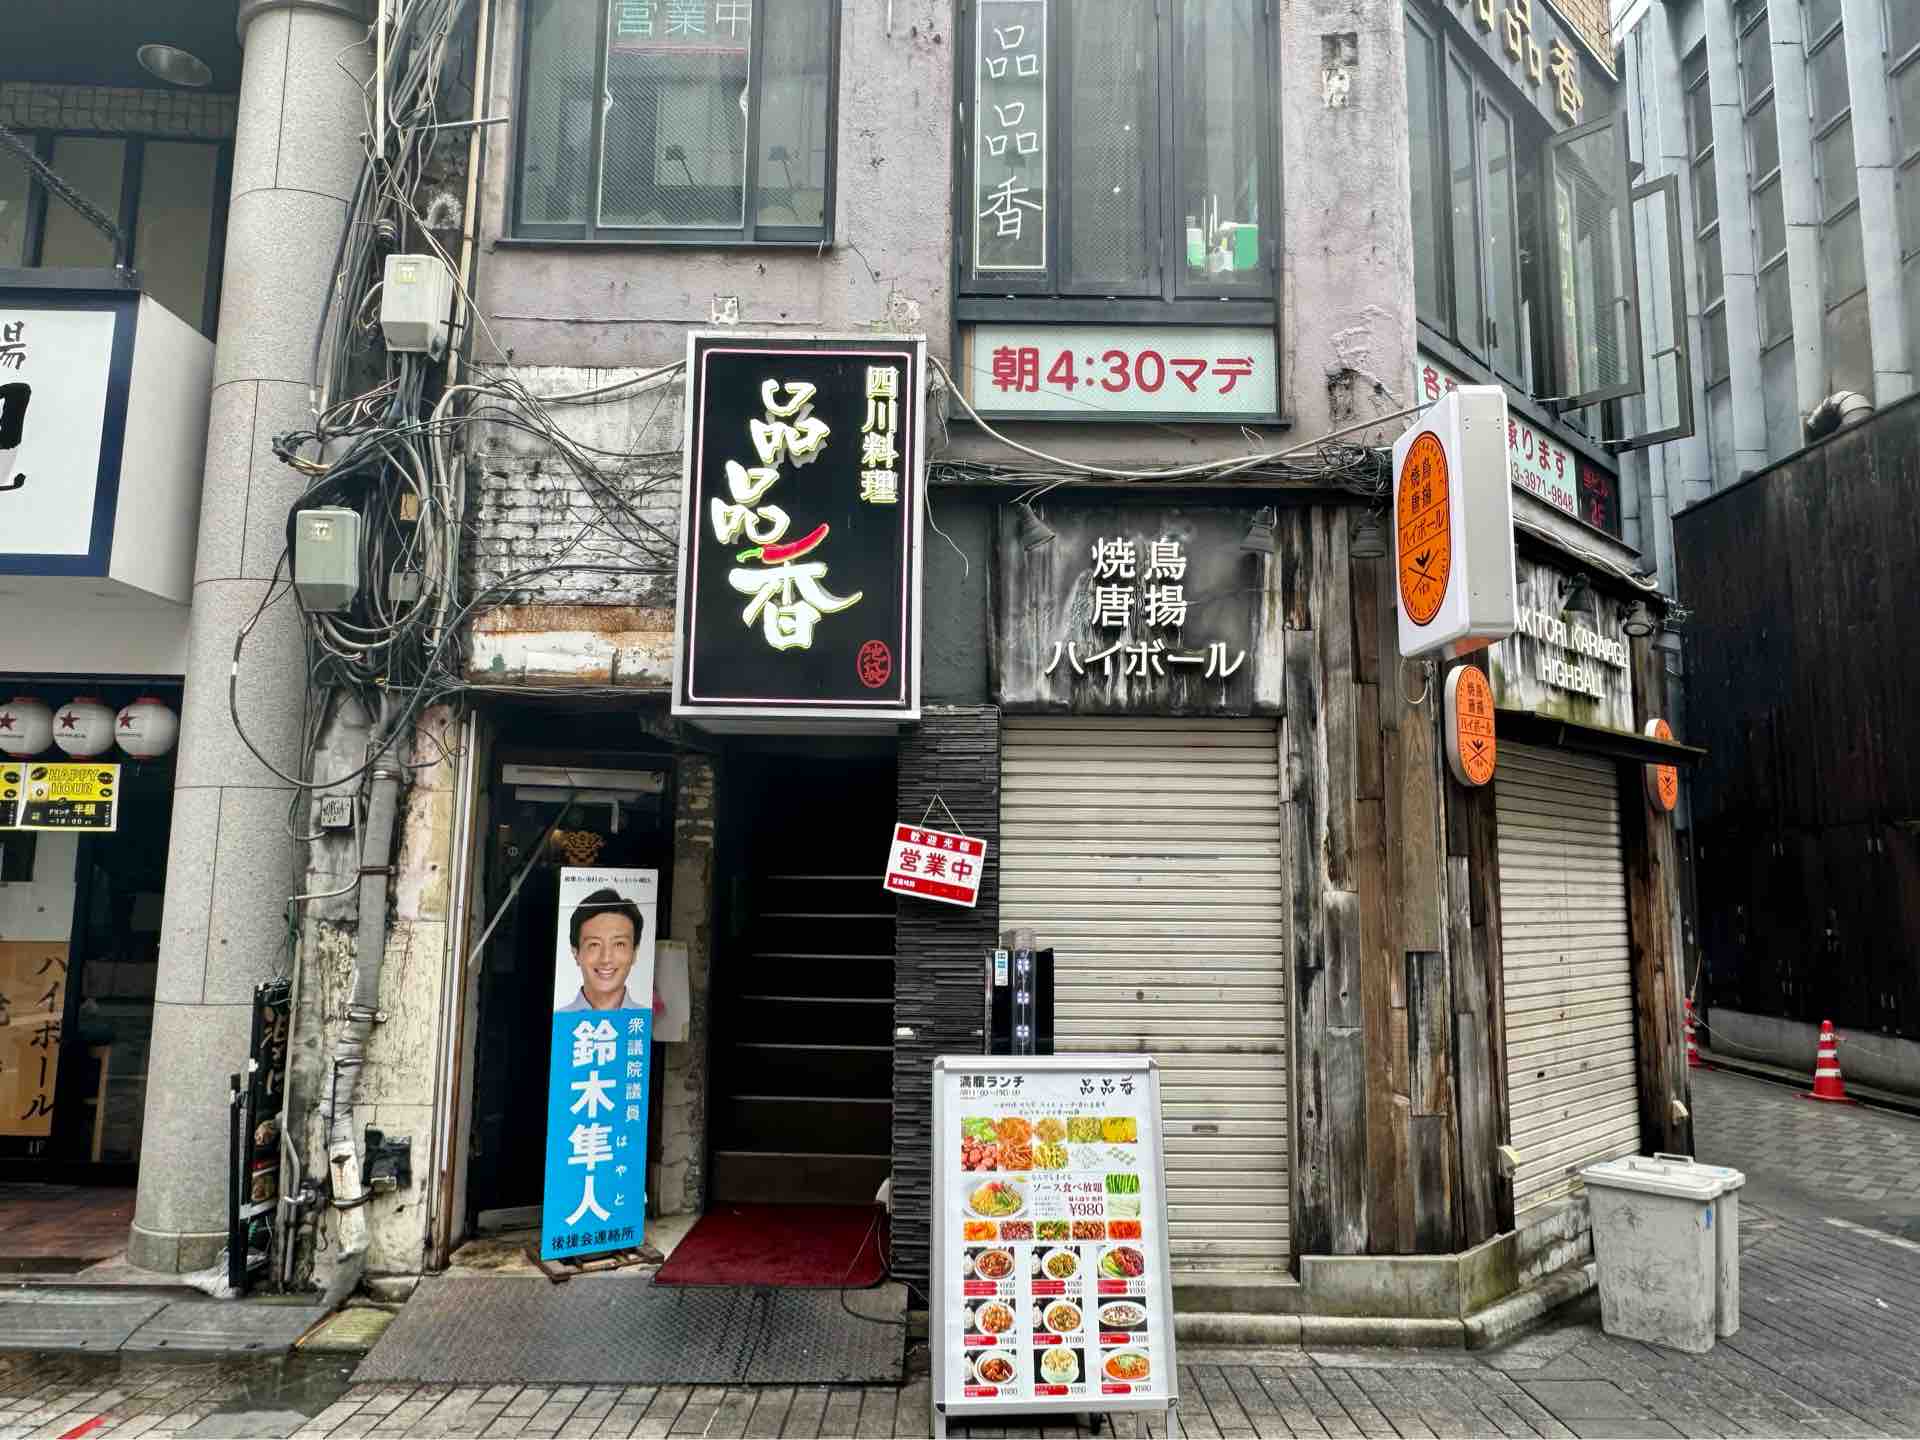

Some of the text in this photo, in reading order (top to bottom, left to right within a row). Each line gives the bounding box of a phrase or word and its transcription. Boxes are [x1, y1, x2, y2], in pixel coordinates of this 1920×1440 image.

[1474, 0, 1584, 125] 品香
[979, 25, 1042, 240] 品品香
[992, 345, 1255, 395] 朝4:30マデ
[860, 365, 899, 504] 四川料理
[1510, 461, 1573, 513] 3-3971-9848
[711, 377, 863, 650] 品品香
[1092, 537, 1187, 580] 焼鳥
[1092, 584, 1188, 627] 唐揚
[1045, 639, 1246, 678] ハイボール
[1542, 655, 1605, 698] HIGHBALL
[900, 847, 973, 881] 営業中
[21, 956, 67, 1121] ハイボール
[625, 1018, 645, 1122] 衆議院議員
[1080, 1075, 1136, 1096] 品品香
[565, 1019, 619, 1226] 鈴木隼人
[614, 1135, 627, 1206] はやと
[1069, 1203, 1104, 1216] ¥980
